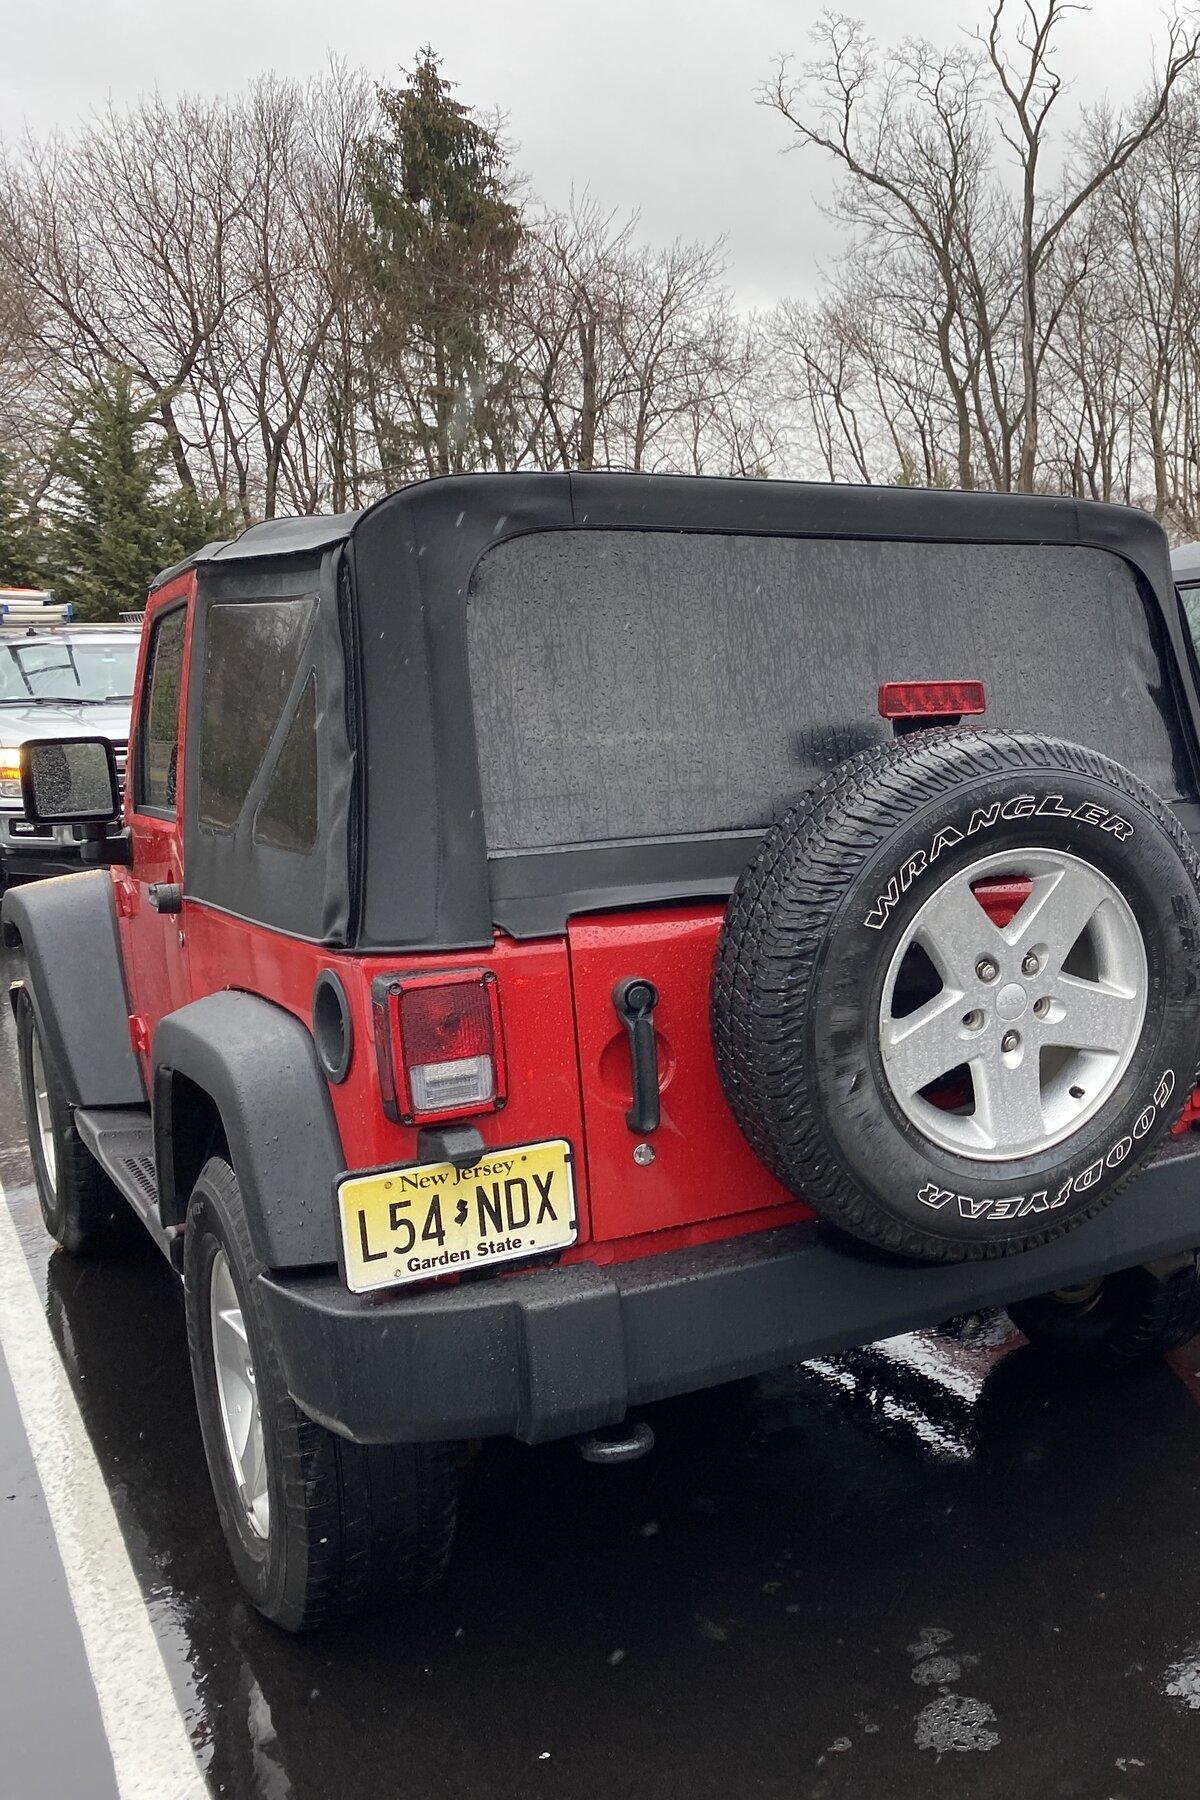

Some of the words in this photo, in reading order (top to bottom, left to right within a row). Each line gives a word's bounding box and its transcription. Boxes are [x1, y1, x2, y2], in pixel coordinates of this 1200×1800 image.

[863, 795, 1136, 931] WRANGLER
[400, 1171, 449, 1193] New
[453, 1158, 515, 1187] Jersey
[917, 1068, 1177, 1220] GOODYEAR
[358, 1194, 446, 1264] L54
[475, 1171, 558, 1238] NDX
[406, 1247, 471, 1273] Garden
[476, 1236, 522, 1257] State
